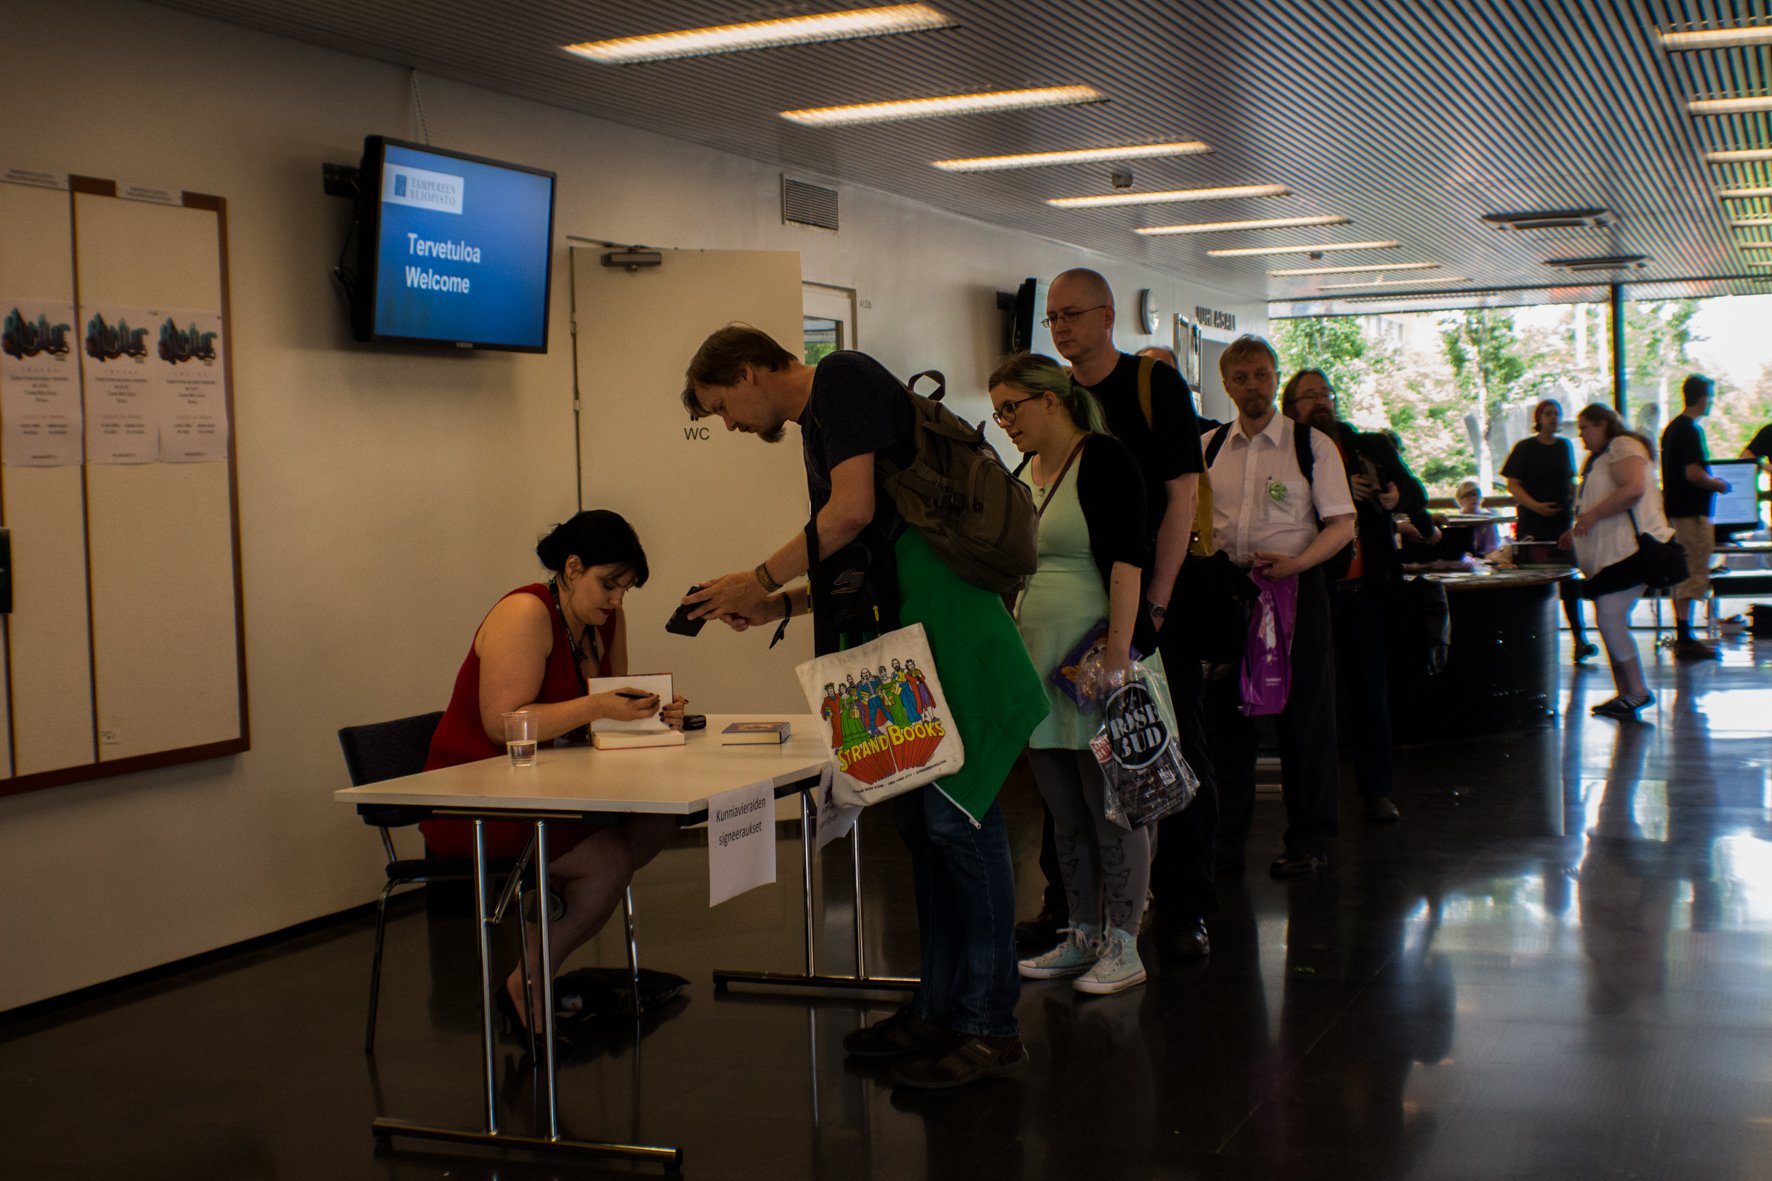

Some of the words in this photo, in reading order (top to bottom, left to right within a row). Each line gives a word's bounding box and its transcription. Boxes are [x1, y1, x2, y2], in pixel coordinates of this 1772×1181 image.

[409, 189, 456, 206] YLIOPISTO
[410, 178, 457, 194] TAMPEREEN
[407, 232, 481, 263] Tervetuloa
[405, 265, 470, 294] Welcome
[684, 427, 710, 440] WC
[886, 720, 946, 746] BOOKS
[1109, 704, 1160, 740] ROSE
[837, 734, 890, 772] STRAND
[1121, 726, 1162, 758] BUD
[716, 797, 766, 823] Kunniavieraiden
[718, 821, 762, 847] signeeraukset
